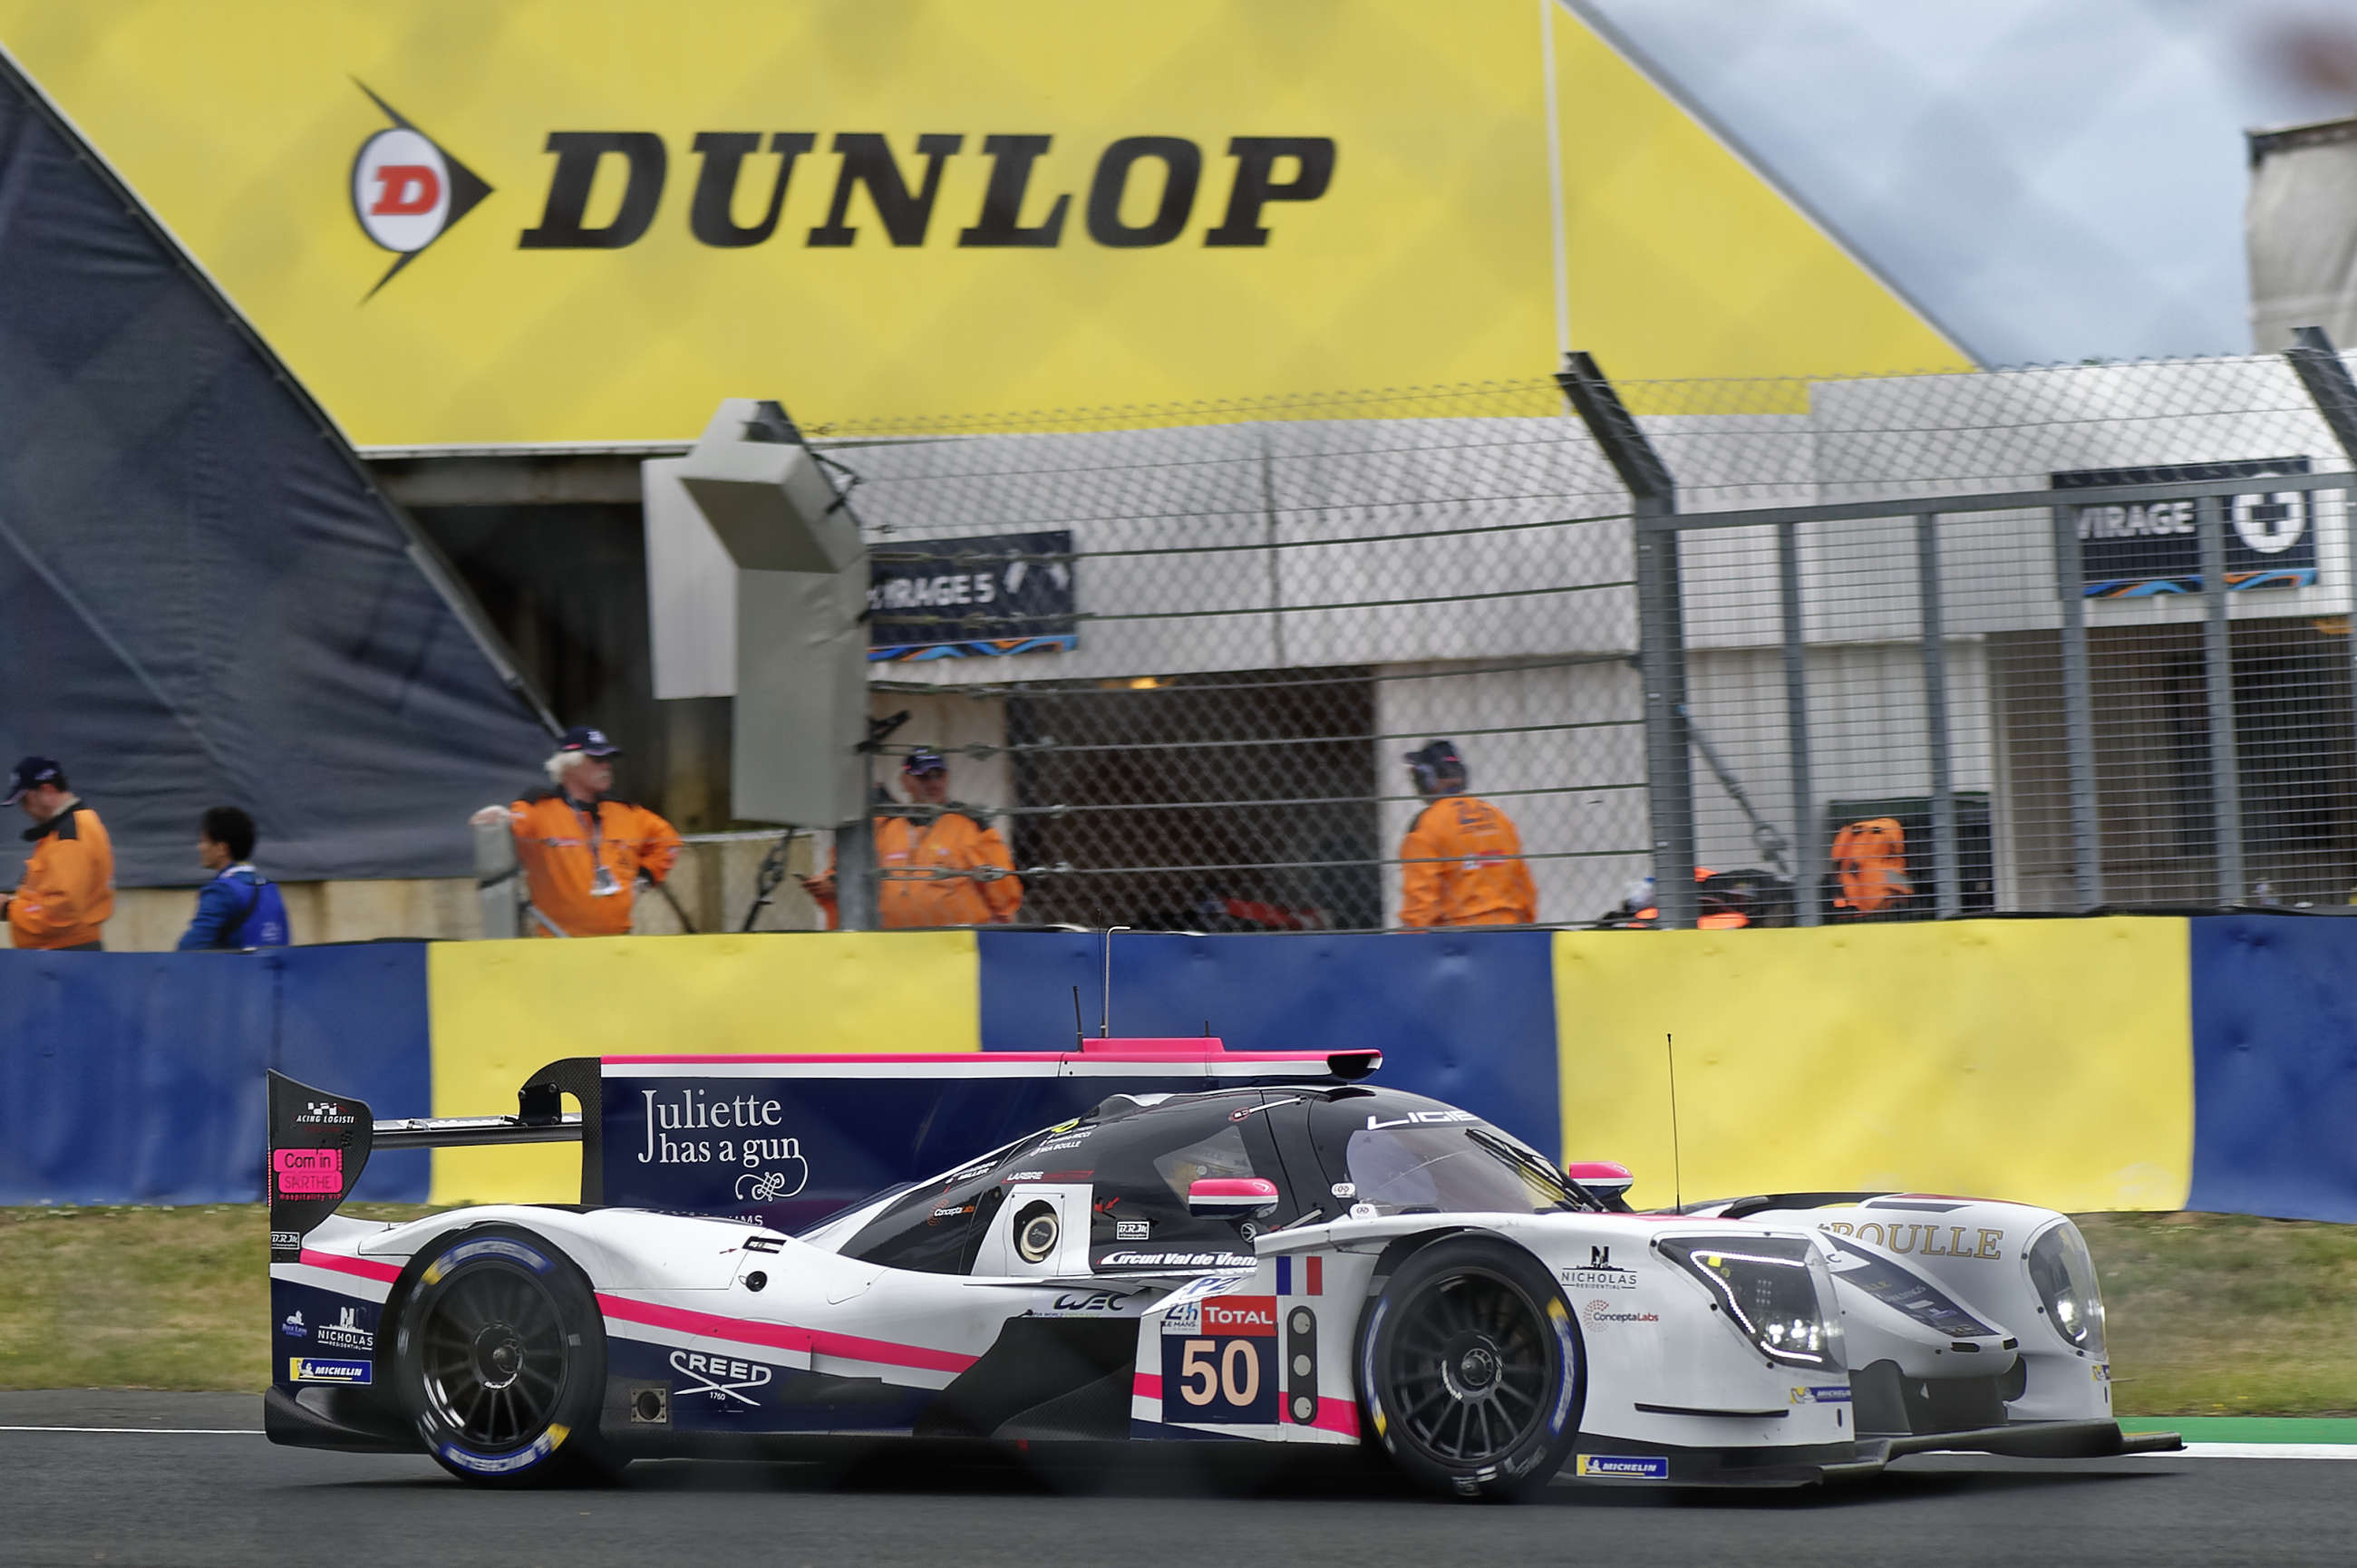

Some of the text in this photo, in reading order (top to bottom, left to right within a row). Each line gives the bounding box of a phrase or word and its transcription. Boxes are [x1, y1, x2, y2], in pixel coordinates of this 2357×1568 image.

[517, 131, 1336, 249] DUNLOP
[974, 573, 995, 604] 5
[296, 1115, 354, 1124] ACING LOGISTI
[638, 1089, 782, 1163] Juliette
[1367, 1110, 1479, 1130] LIGIE
[659, 1133, 804, 1168] has a gun
[1100, 1251, 1166, 1265] Circuit
[1163, 1253, 1190, 1265] Val
[1190, 1253, 1214, 1265] de
[1188, 1276, 1242, 1294] P2
[1561, 1272, 1637, 1284] NICHOLAS
[1052, 1293, 1130, 1312] WEC
[1205, 1306, 1274, 1324] TOTAL
[1593, 1312, 1658, 1323] ConceptaLabs
[317, 1330, 373, 1347] NICHOLAS
[315, 1367, 363, 1377] MICHELIN
[669, 1350, 771, 1386] CREED
[1180, 1339, 1260, 1407] 50
[710, 1391, 725, 1400] 1760
[1602, 1463, 1656, 1472] MICHELIN
